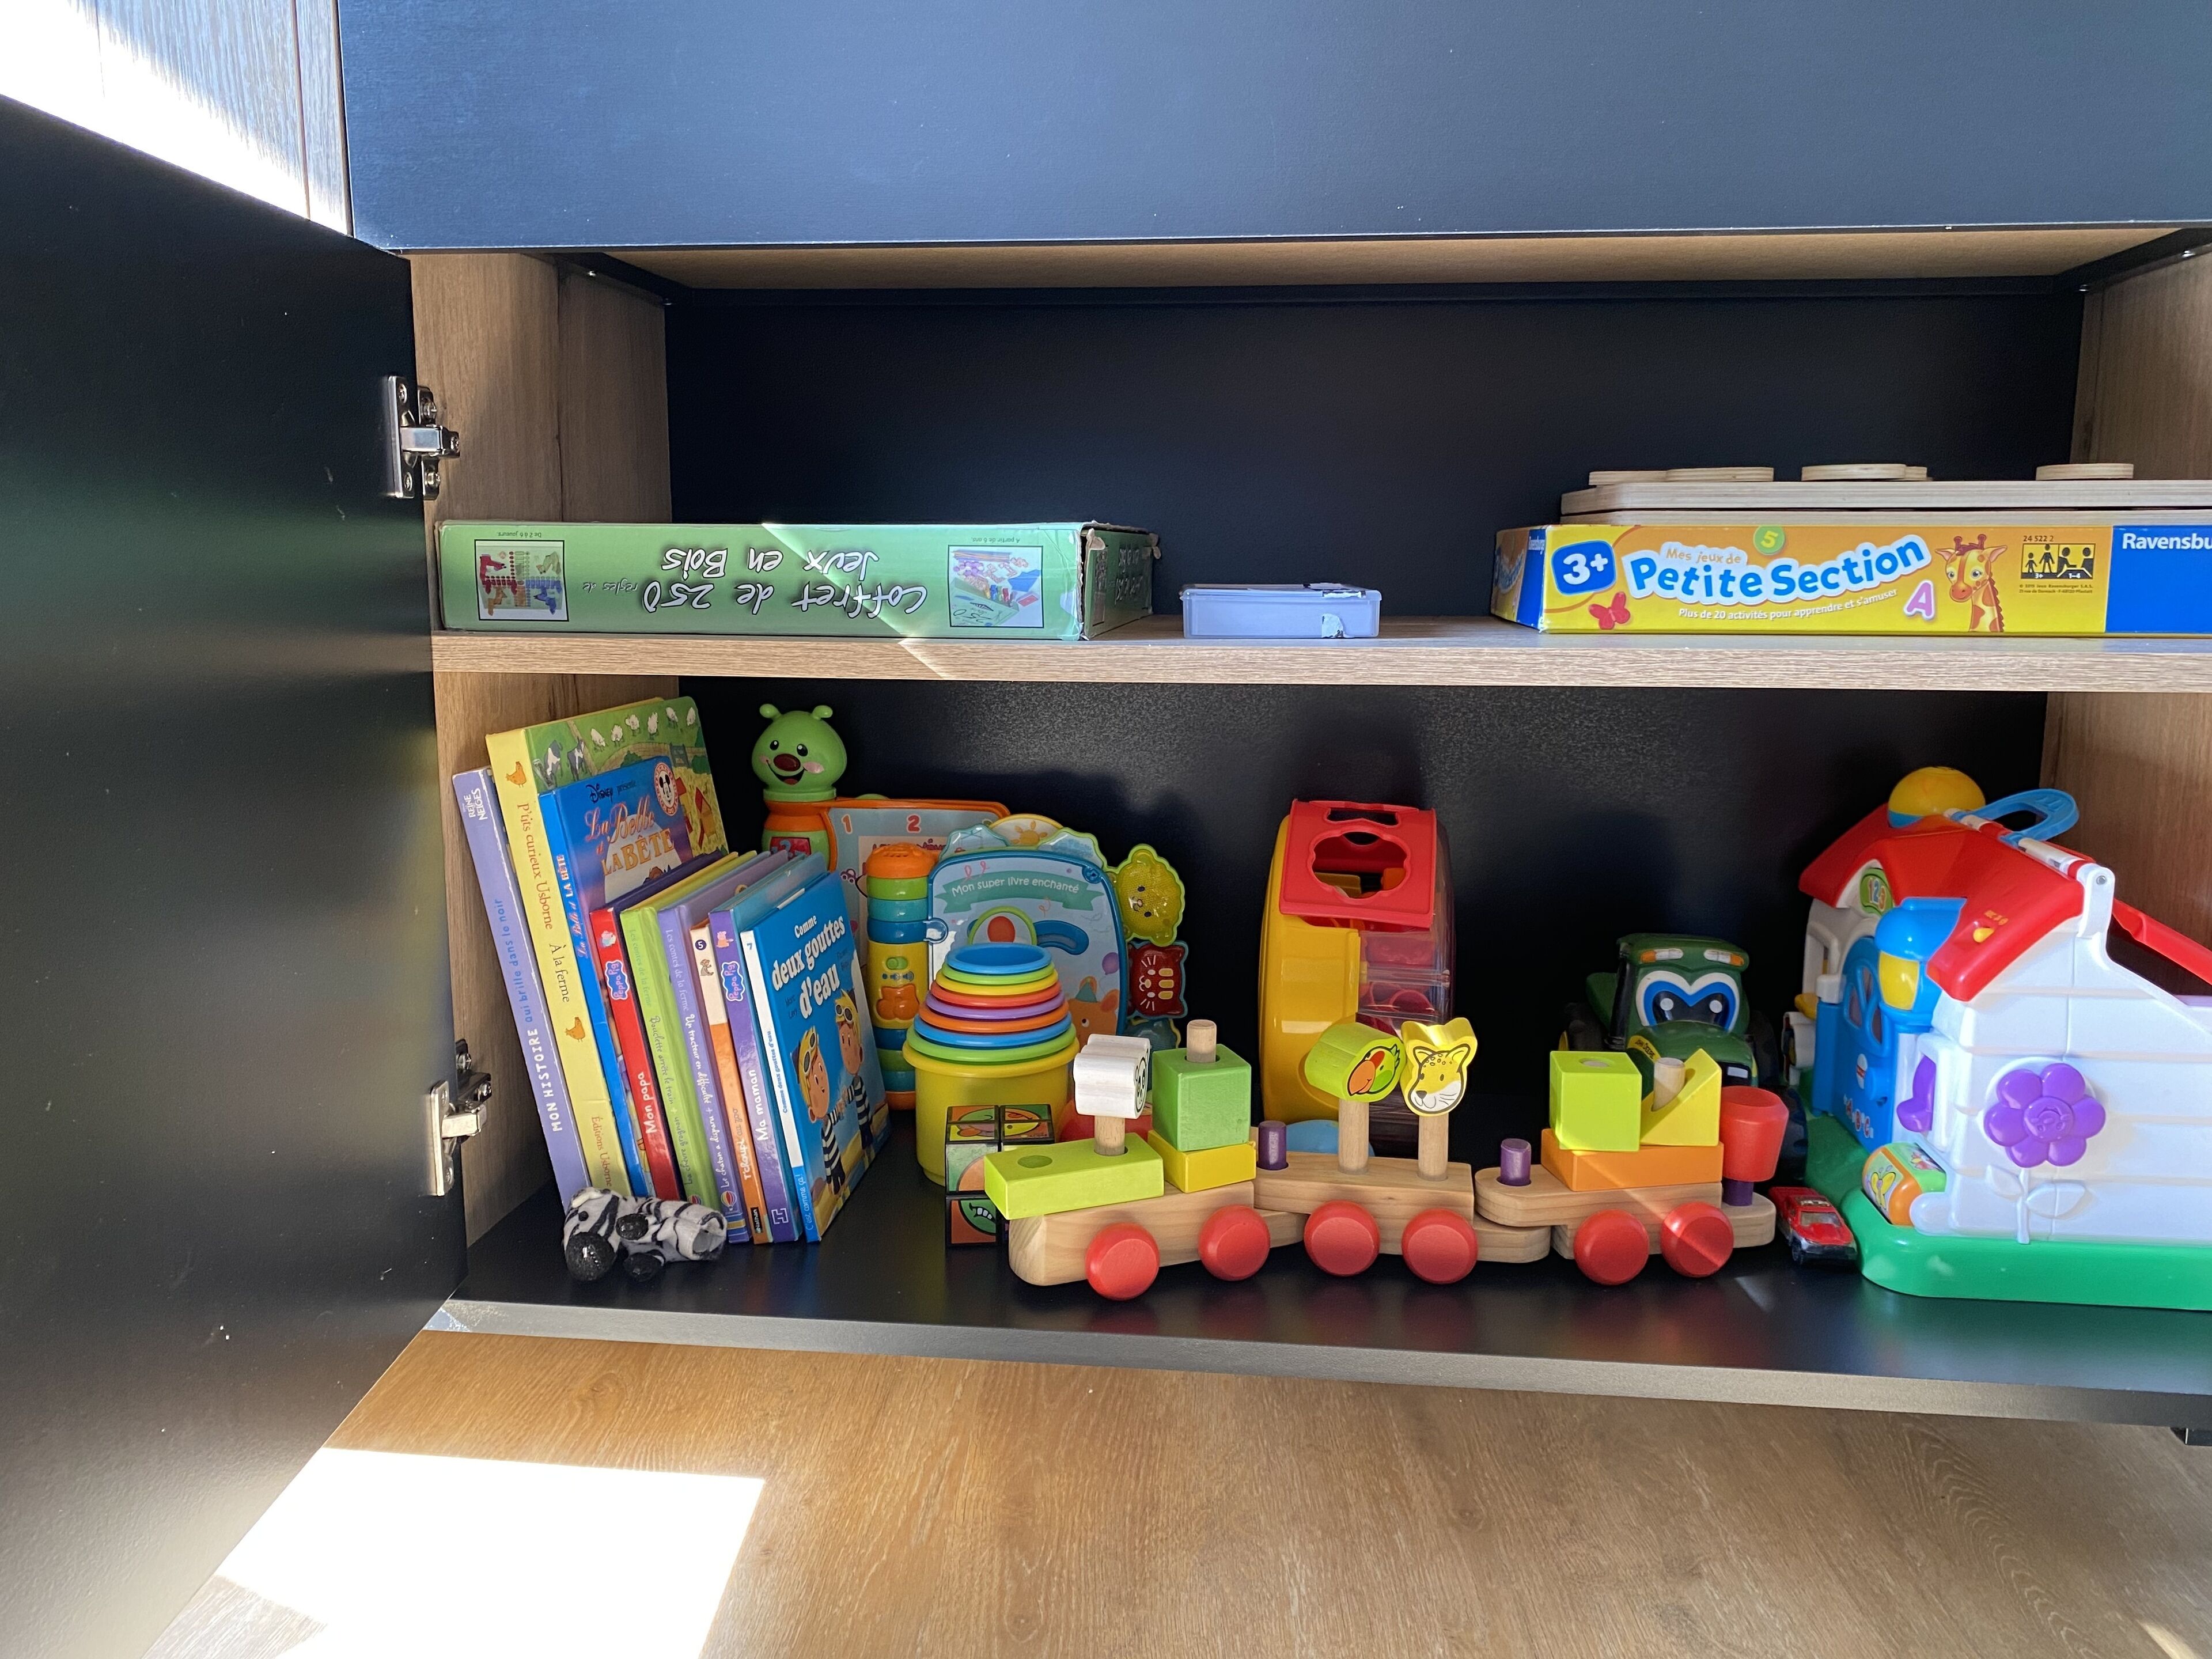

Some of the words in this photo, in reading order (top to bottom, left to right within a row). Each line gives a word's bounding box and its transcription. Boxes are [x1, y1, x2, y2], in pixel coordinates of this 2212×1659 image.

[1760, 531, 1779, 548] 5
[2122, 533, 2212, 550] Ravensbu
[661, 548, 728, 579] Bois
[749, 548, 783, 572] en
[804, 550, 879, 581] Jeux
[1563, 553, 1608, 585] 3+
[1631, 556, 1763, 598] Petite
[1771, 541, 1925, 596] Section
[1666, 548, 1692, 561] Mes
[1696, 550, 1722, 563] jeux
[1726, 554, 1741, 564] de
[643, 581, 714, 613] 250
[736, 583, 774, 615] de
[791, 582, 927, 619] Coffret
[1679, 608, 1698, 618] Plus
[1700, 609, 1712, 618] de
[1714, 610, 1726, 619] 20
[1728, 609, 1768, 620] activités
[1770, 609, 1791, 620] pour
[1794, 603, 1843, 618] apprendre
[1844, 600, 1854, 609] et
[1856, 589, 1899, 607] s'amuser
[1904, 579, 1934, 618] A
[463, 793, 476, 818] REINE
[471, 787, 488, 820] NEIGES
[585, 807, 611, 842] La
[607, 794, 655, 844] Belle
[841, 814, 853, 834] 1
[907, 814, 922, 833] 2
[620, 828, 675, 871] BÊTE
[526, 834, 542, 878] curieux
[537, 880, 552, 929] Usborne
[563, 883, 574, 897] LA
[951, 884, 975, 897] Mon
[977, 878, 1005, 892] super
[1007, 876, 1029, 885] livre
[1032, 878, 1079, 893] enchanté
[494, 899, 507, 922] noir
[502, 926, 510, 938] le
[794, 915, 817, 938] Comme
[507, 941, 519, 967] dans
[549, 944, 566, 955] À
[698, 941, 704, 949] 5
[772, 949, 805, 991] deux
[805, 915, 846, 971] gouttes
[553, 955, 565, 965] la
[608, 962, 620, 975] Pig
[724, 963, 736, 976] Pig
[513, 970, 528, 1004] brille
[556, 970, 570, 1003] ferme
[613, 975, 626, 998] Peppa
[669, 944, 679, 968] contes
[675, 969, 683, 978] de
[679, 989, 689, 1011] ferme
[728, 976, 743, 999] Peppa
[800, 964, 840, 1018] d'eau
[520, 1008, 533, 1024] qui
[649, 1016, 662, 1053] Bouclette
[527, 1028, 554, 1098] HISTOIRE
[685, 1014, 695, 1028] Un
[690, 1029, 700, 1059] tracteur
[697, 1069, 711, 1104] difficulté
[771, 1049, 781, 1073] gouttes
[638, 1071, 654, 1101] papa
[748, 1069, 764, 1115] maman
[546, 1102, 563, 1132] MON
[643, 1106, 657, 1134] Mon
[709, 1116, 721, 1143] disparu
[757, 1119, 769, 1141] Ma
[675, 1117, 688, 1147] grognon
[592, 1116, 604, 1151] Éditions
[600, 1152, 612, 1187] Usborne
[715, 1152, 728, 1176] chaton
[721, 1178, 730, 1188] Le
[801, 1186, 811, 1211] comme
[805, 1212, 814, 1230] C'est
